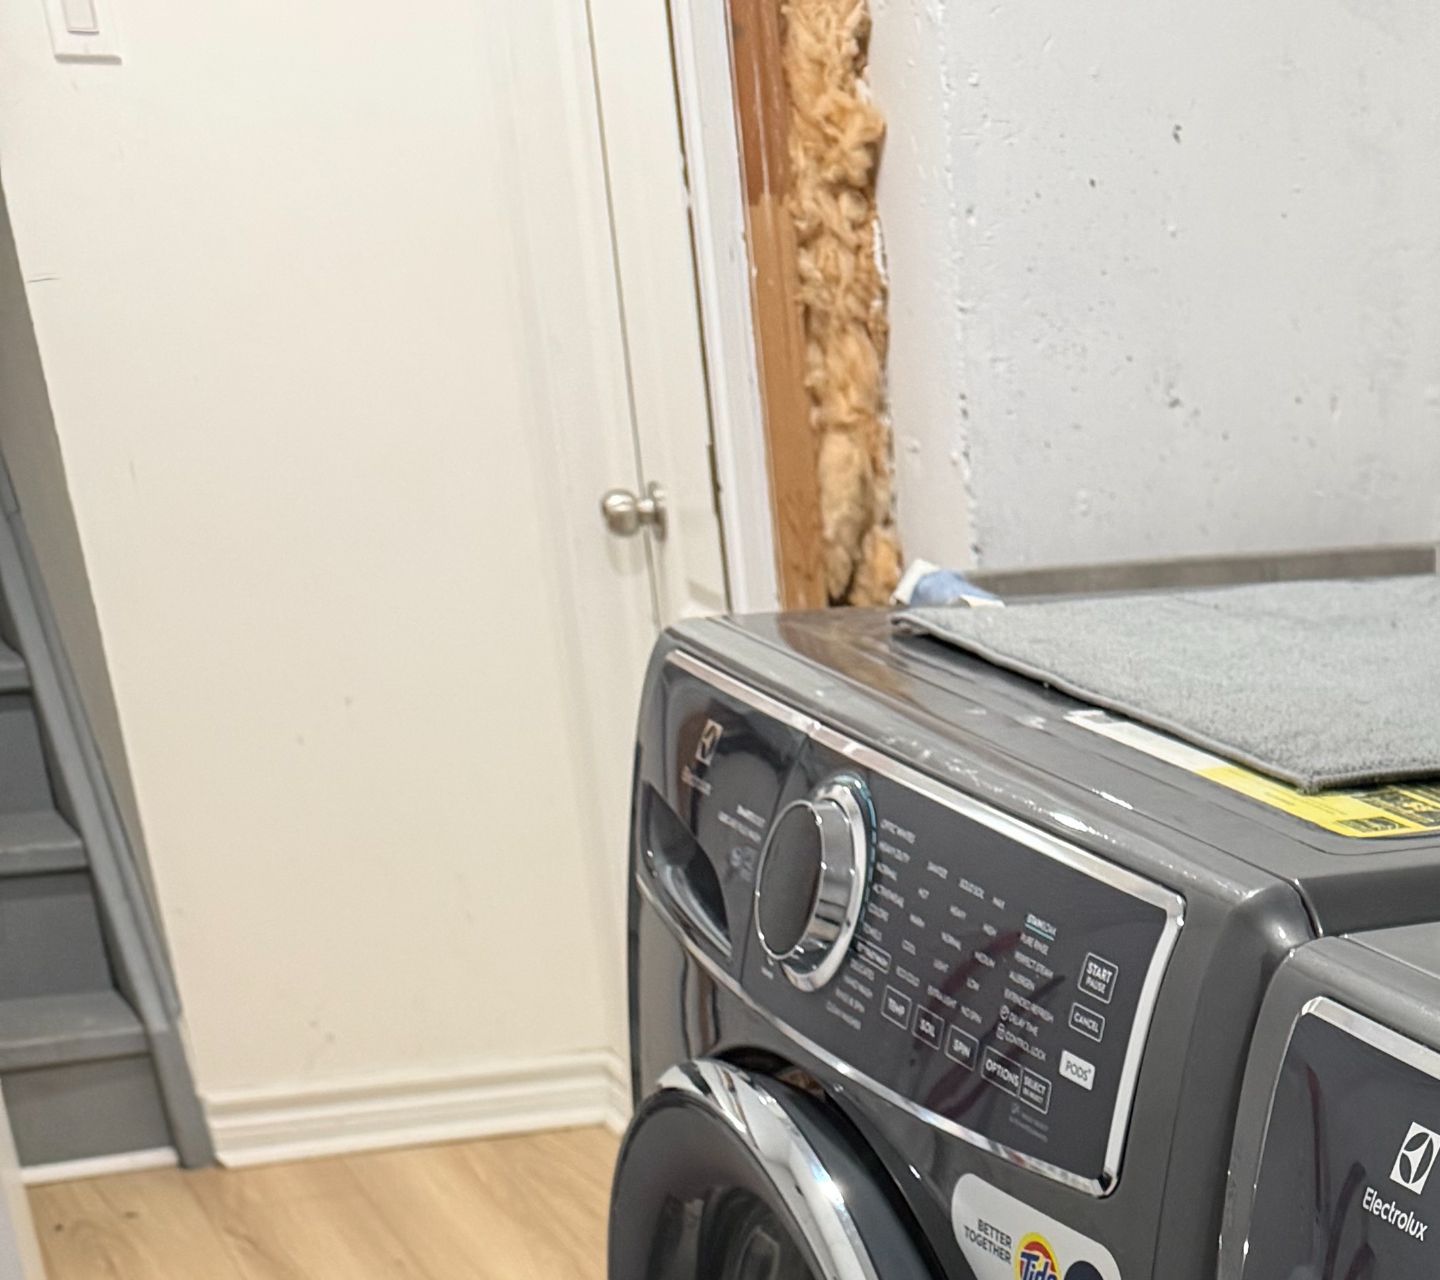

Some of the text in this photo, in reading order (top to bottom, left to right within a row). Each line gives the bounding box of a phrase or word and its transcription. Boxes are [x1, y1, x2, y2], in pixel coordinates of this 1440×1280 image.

[1087, 961, 1113, 983] START
[1073, 1012, 1099, 1033] CANCEL
[985, 1058, 1020, 1088] OPTIONS
[1362, 1187, 1428, 1241] Electrolux
[964, 1226, 1012, 1264] TOGETHER
[978, 1219, 1012, 1248] BETTER
